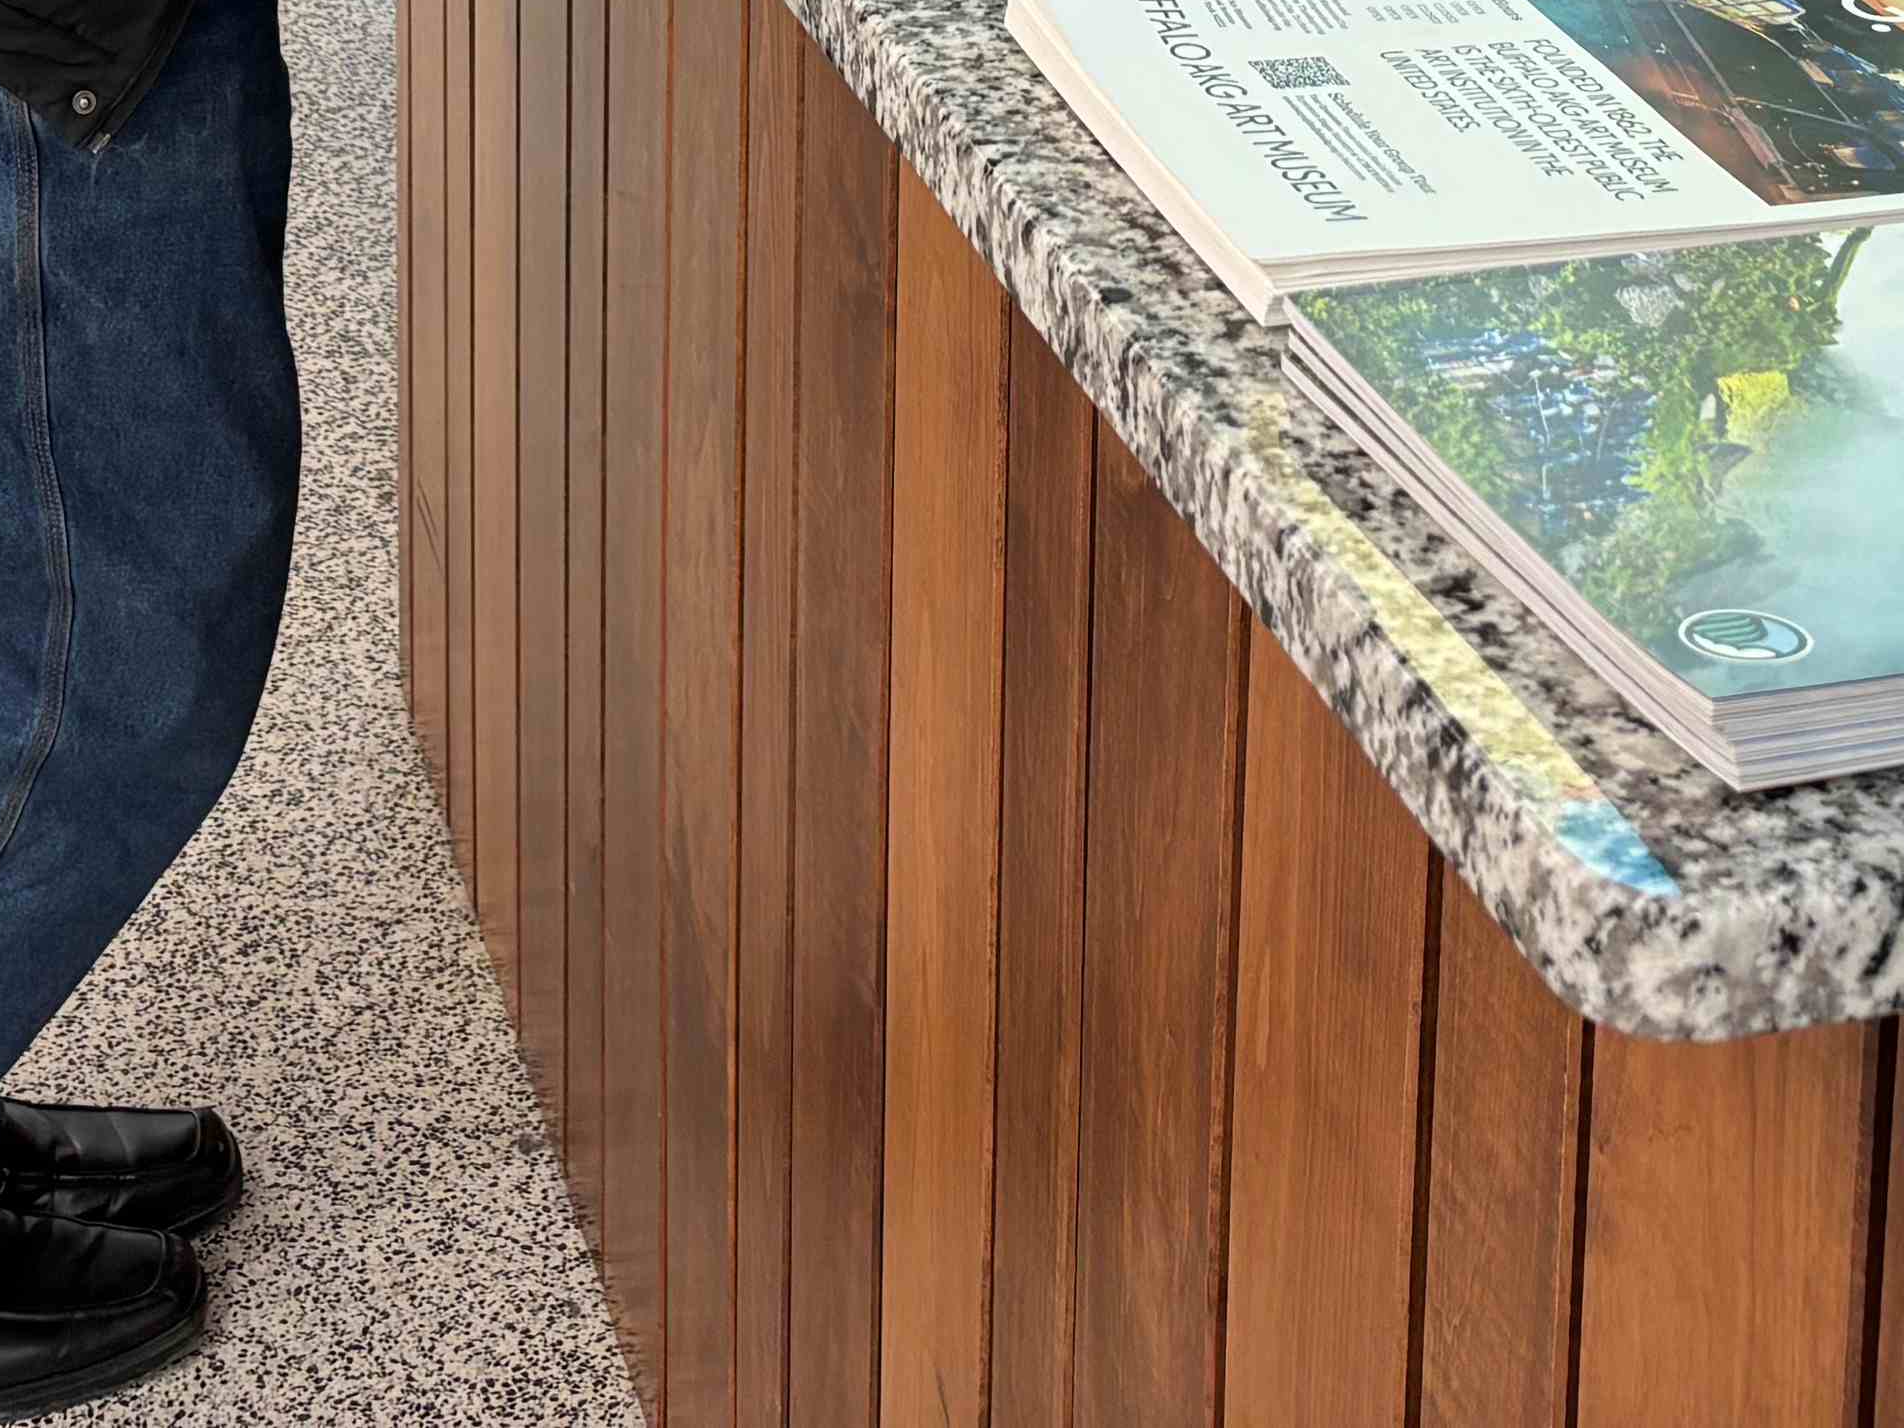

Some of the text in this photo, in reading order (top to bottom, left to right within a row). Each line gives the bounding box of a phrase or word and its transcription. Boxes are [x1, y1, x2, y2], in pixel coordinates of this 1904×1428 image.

[1179, 62, 1248, 99] AKG
[1216, 102, 1286, 136] ART
[1252, 139, 1368, 222] MUSEUM
[1379, 50, 1480, 133] UNITED STATES.
